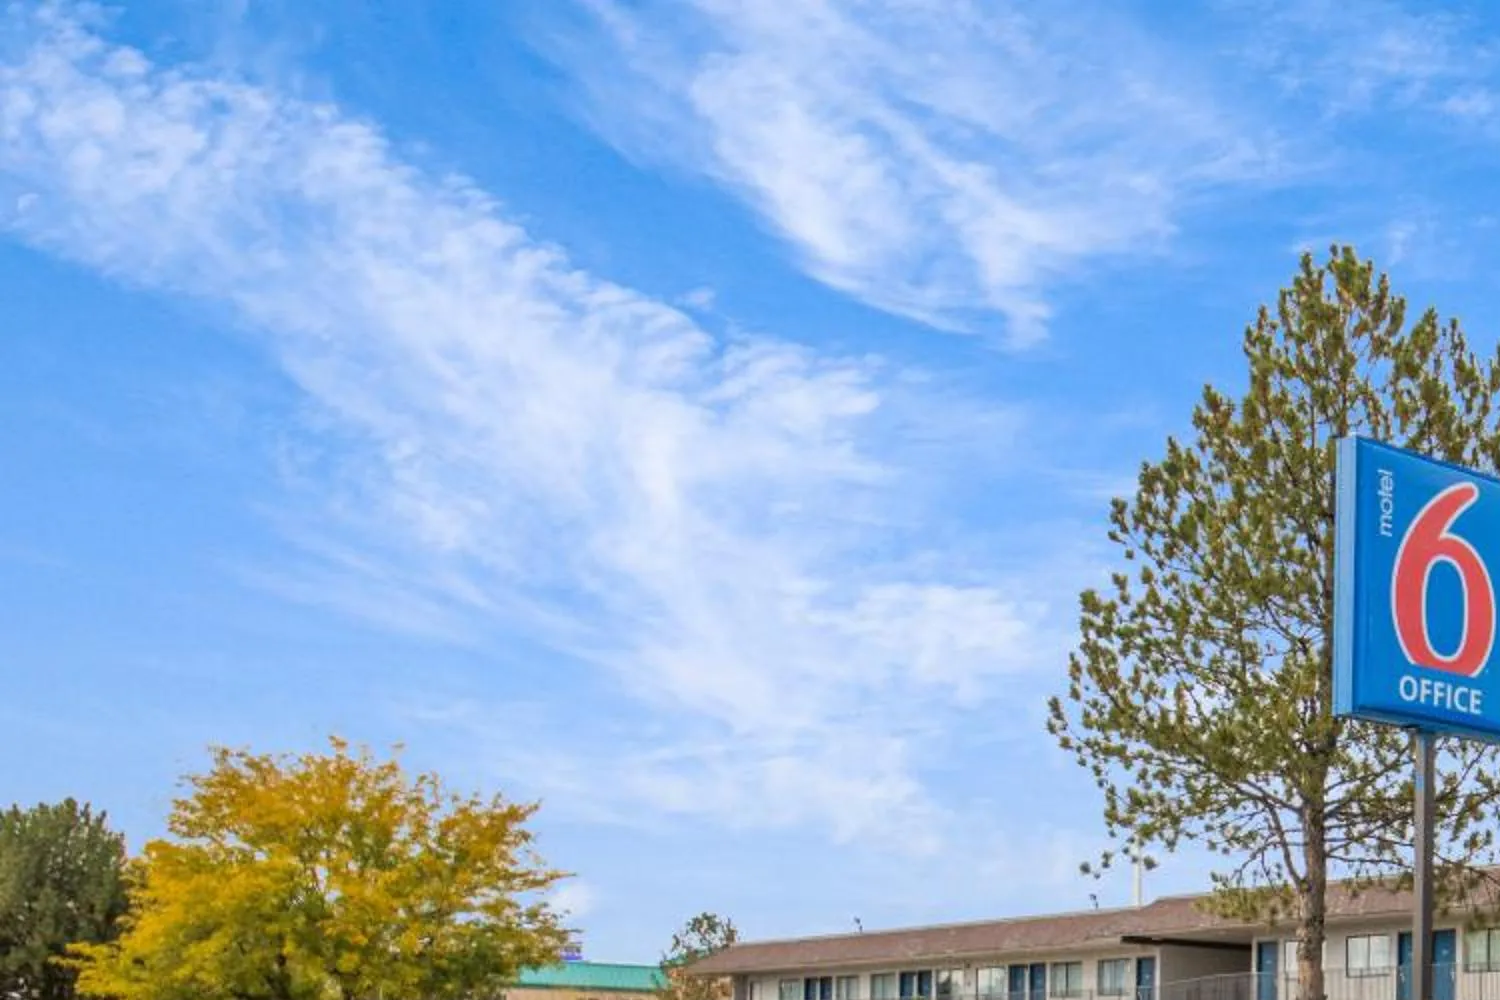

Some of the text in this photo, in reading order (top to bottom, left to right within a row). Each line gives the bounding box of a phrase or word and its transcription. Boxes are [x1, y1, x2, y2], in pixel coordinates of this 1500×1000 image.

[1378, 469, 1393, 537] motel
[1391, 481, 1496, 678] 6
[1399, 675, 1483, 714] OFFICE
